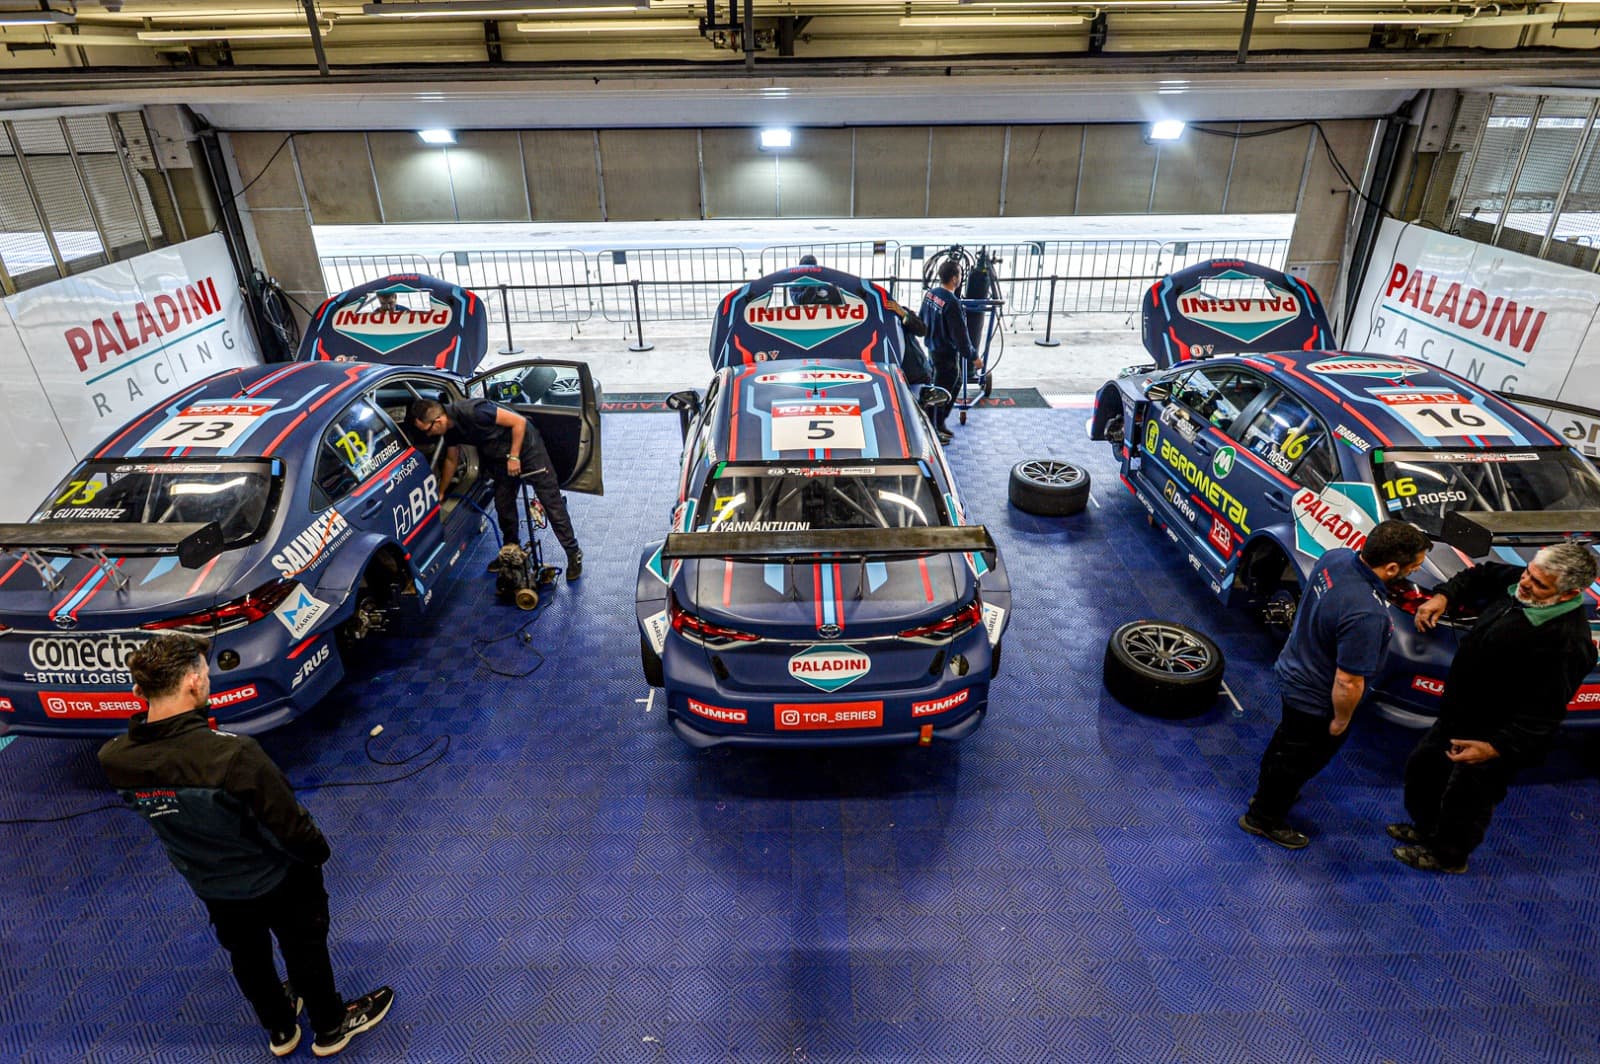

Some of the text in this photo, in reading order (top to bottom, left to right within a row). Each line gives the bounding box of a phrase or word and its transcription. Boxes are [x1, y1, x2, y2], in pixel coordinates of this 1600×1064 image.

[335, 308, 449, 326] PALADINI
[749, 303, 865, 323] PALADINI
[1385, 262, 1548, 353] PALADINI
[64, 276, 222, 373] PALADINI
[1372, 316, 1519, 393] RACING
[92, 329, 235, 418] RACING
[1416, 408, 1486, 428] 16
[162, 421, 234, 441] 73
[807, 420, 835, 440] 5
[335, 431, 367, 465] 73
[1280, 427, 1310, 459] 16
[1266, 448, 1293, 472] ROSSO
[55, 480, 104, 506] 73
[1382, 477, 1418, 499] 16
[1405, 490, 1467, 507] J. ROSSO
[53, 508, 127, 520] GUTIERREZ
[712, 495, 738, 522] 5
[271, 506, 348, 579] SALWEEN
[295, 604, 321, 633] MARELLI
[988, 610, 999, 638] ARELLI
[29, 634, 147, 671] conecta
[792, 658, 867, 673] PALADINI
[37, 672, 133, 684] BTTN LOGIST
[67, 701, 142, 713] TCR_SERIES
[688, 701, 746, 721] KUMHO
[914, 691, 968, 714] KUMHO
[803, 710, 877, 723] TCR_SERIES
